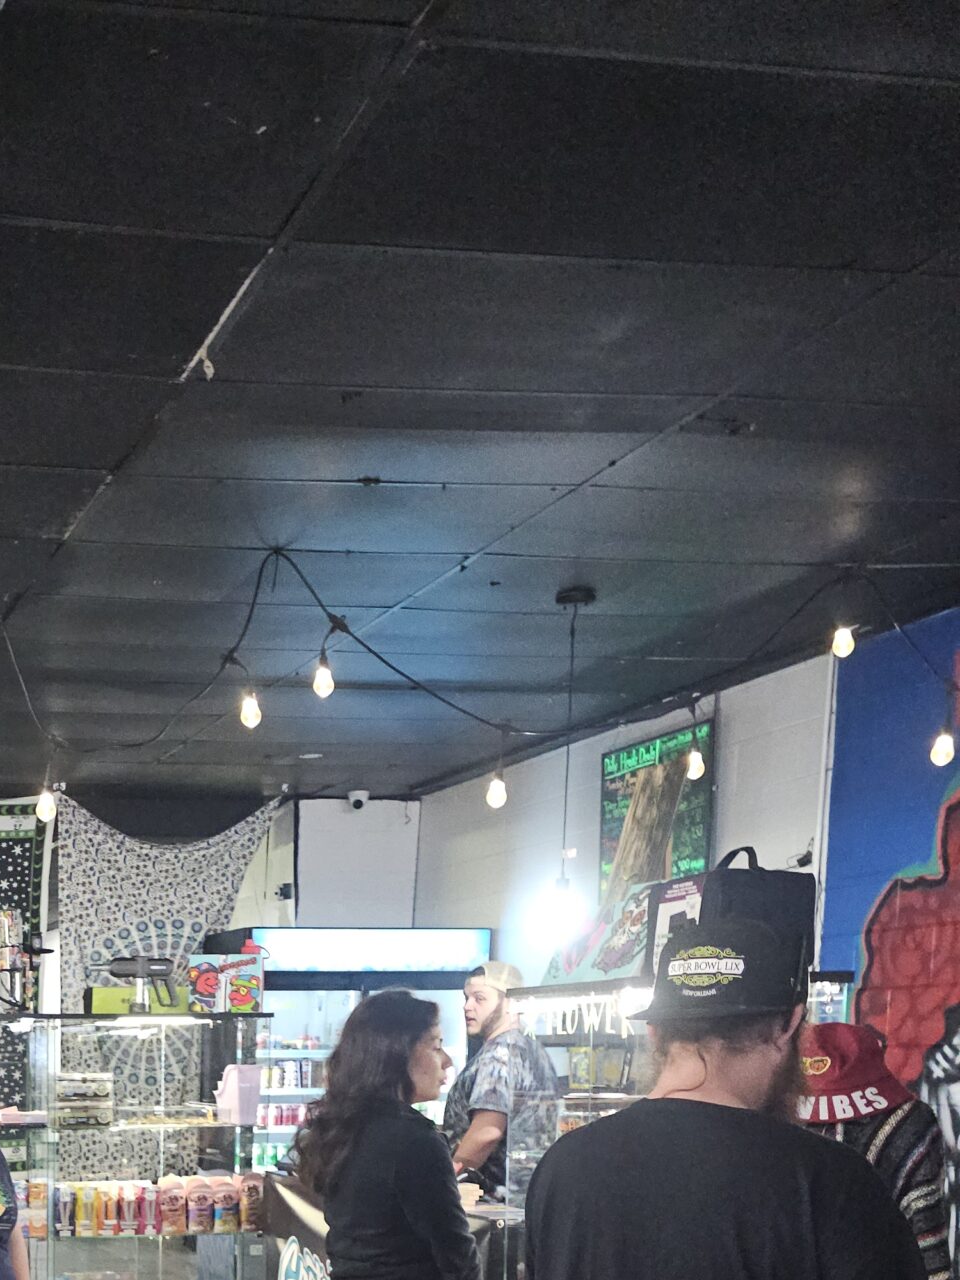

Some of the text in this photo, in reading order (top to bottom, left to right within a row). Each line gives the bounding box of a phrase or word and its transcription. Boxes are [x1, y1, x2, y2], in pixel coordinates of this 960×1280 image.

[671, 960, 740, 973] SUPER BOWL LIX
[797, 1087, 888, 1120] VIBES
